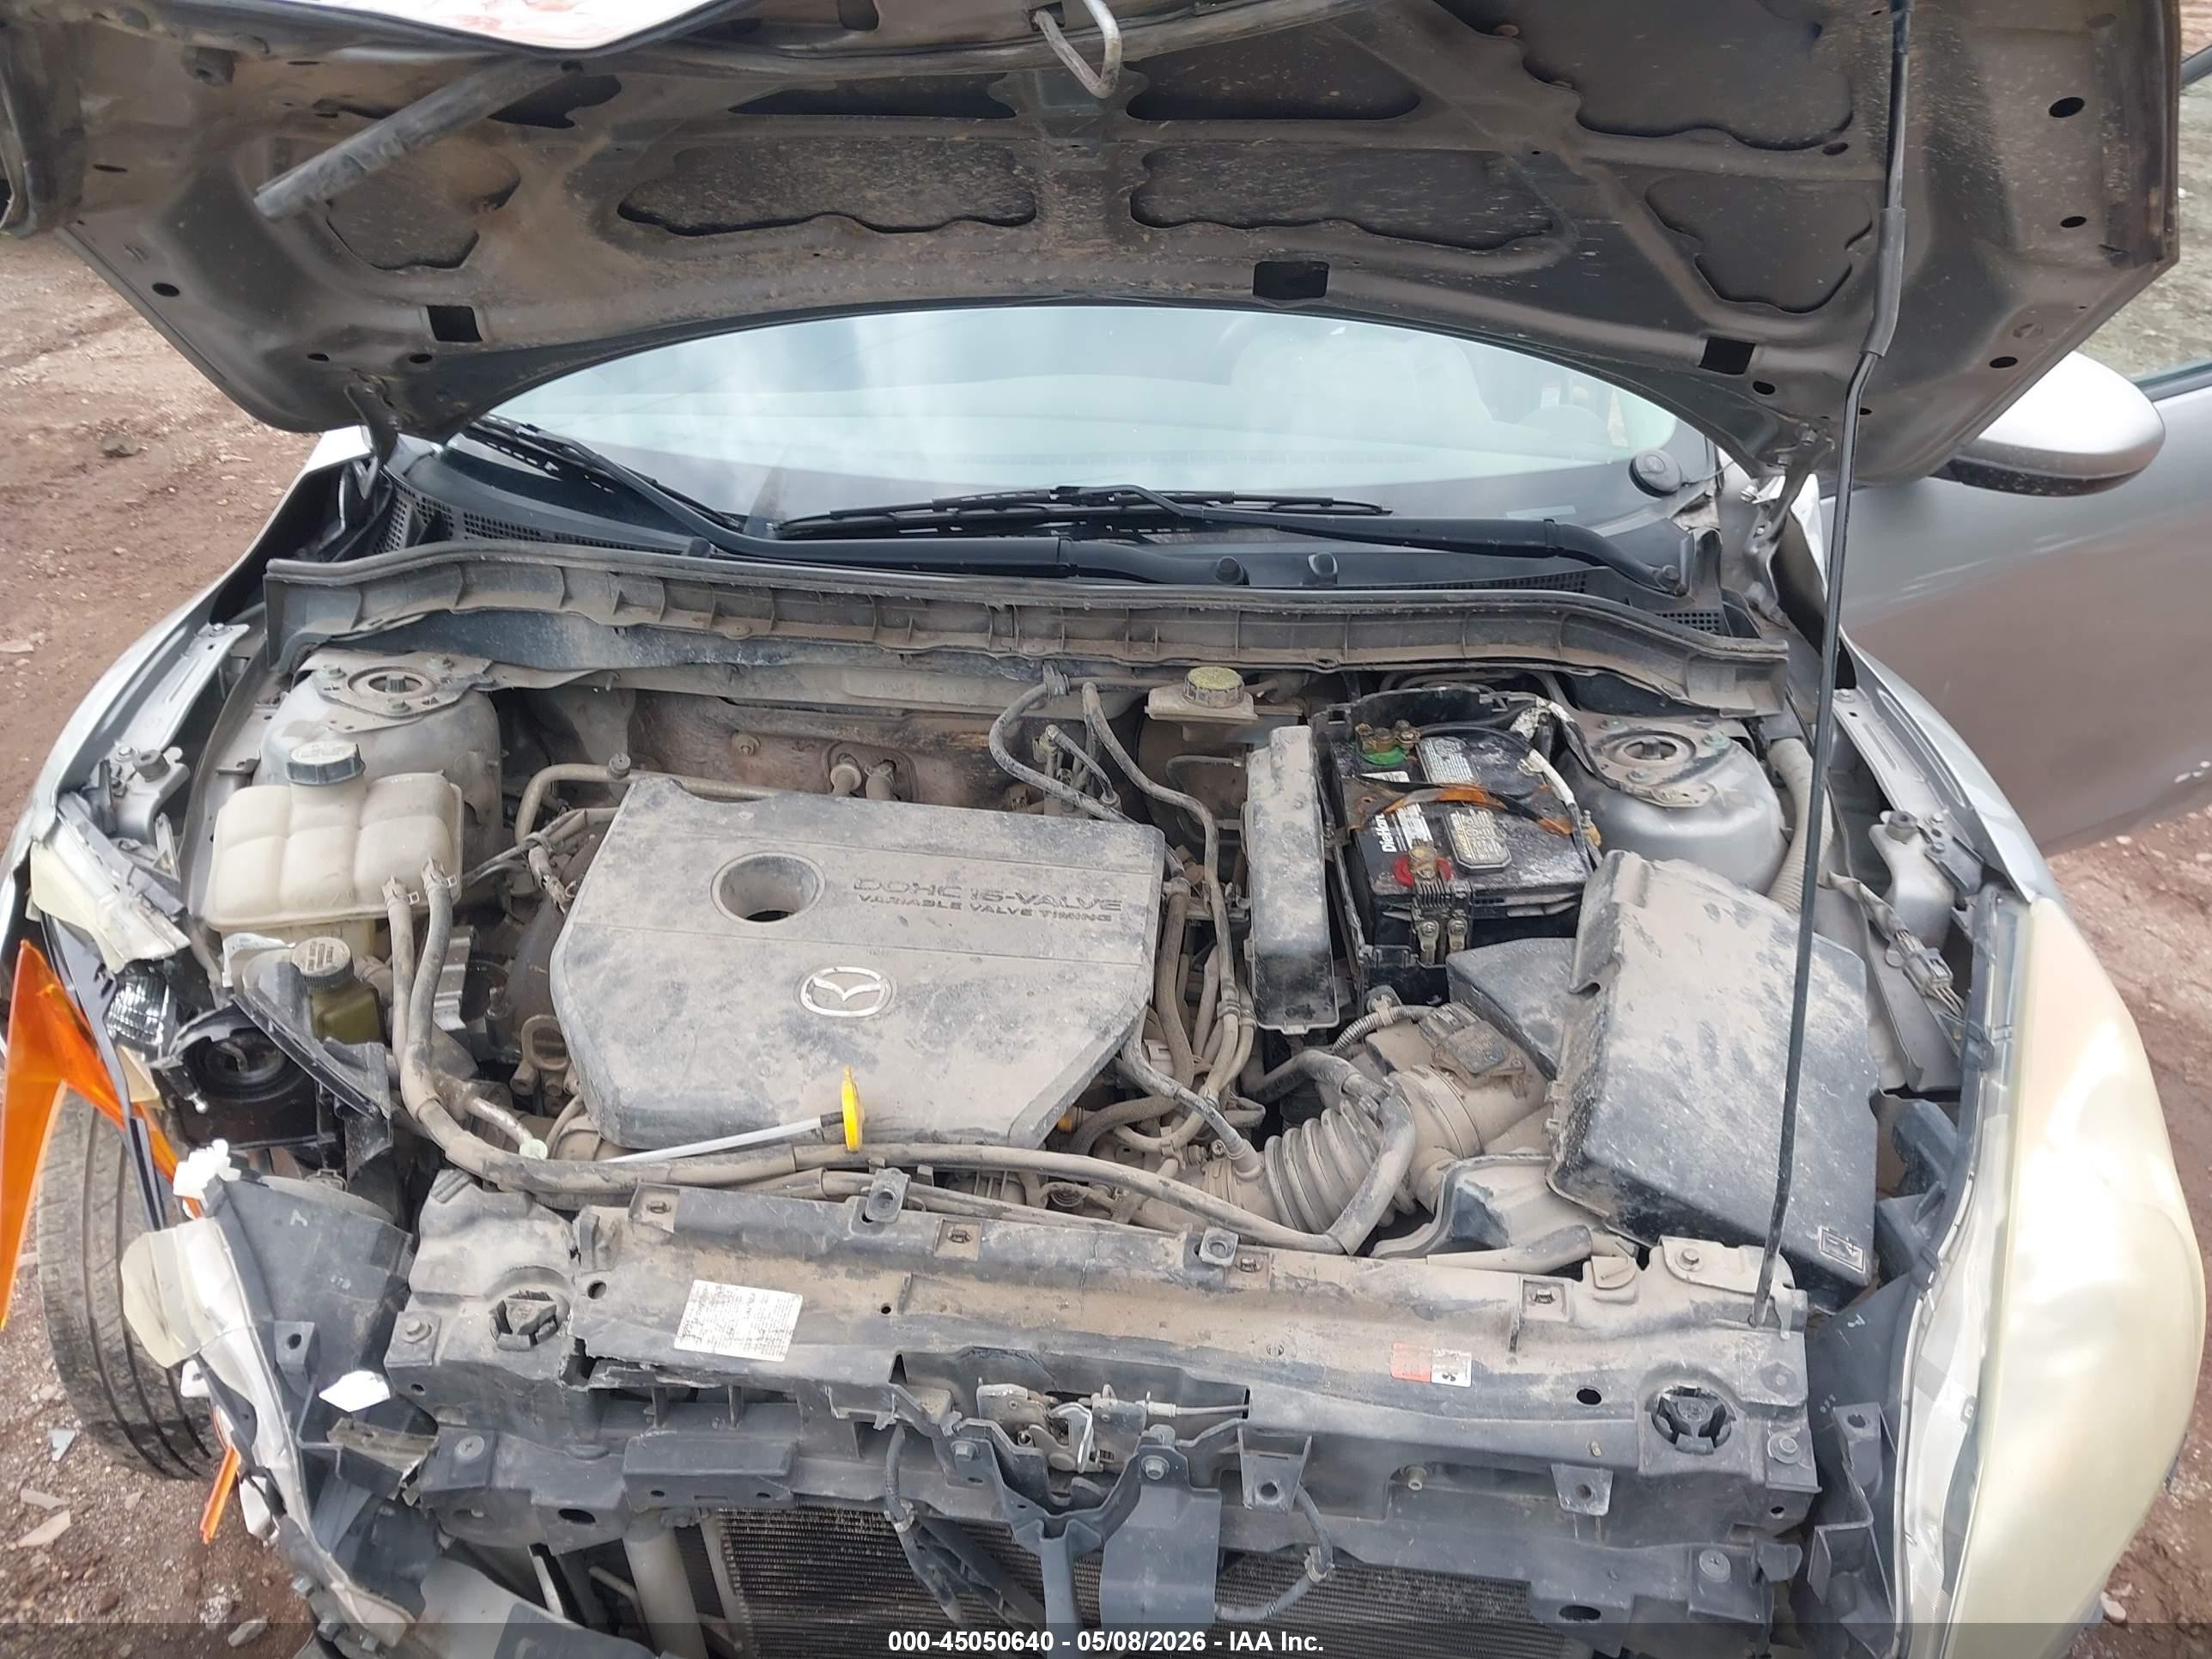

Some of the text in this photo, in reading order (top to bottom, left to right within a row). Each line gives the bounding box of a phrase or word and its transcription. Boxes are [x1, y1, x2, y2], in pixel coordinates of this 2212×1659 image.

[1375, 812, 1398, 853] DieHar
[854, 878, 1122, 912] DOHC 16-VALVE
[859, 894, 1112, 922] VARIABLE VALVE TIMING
